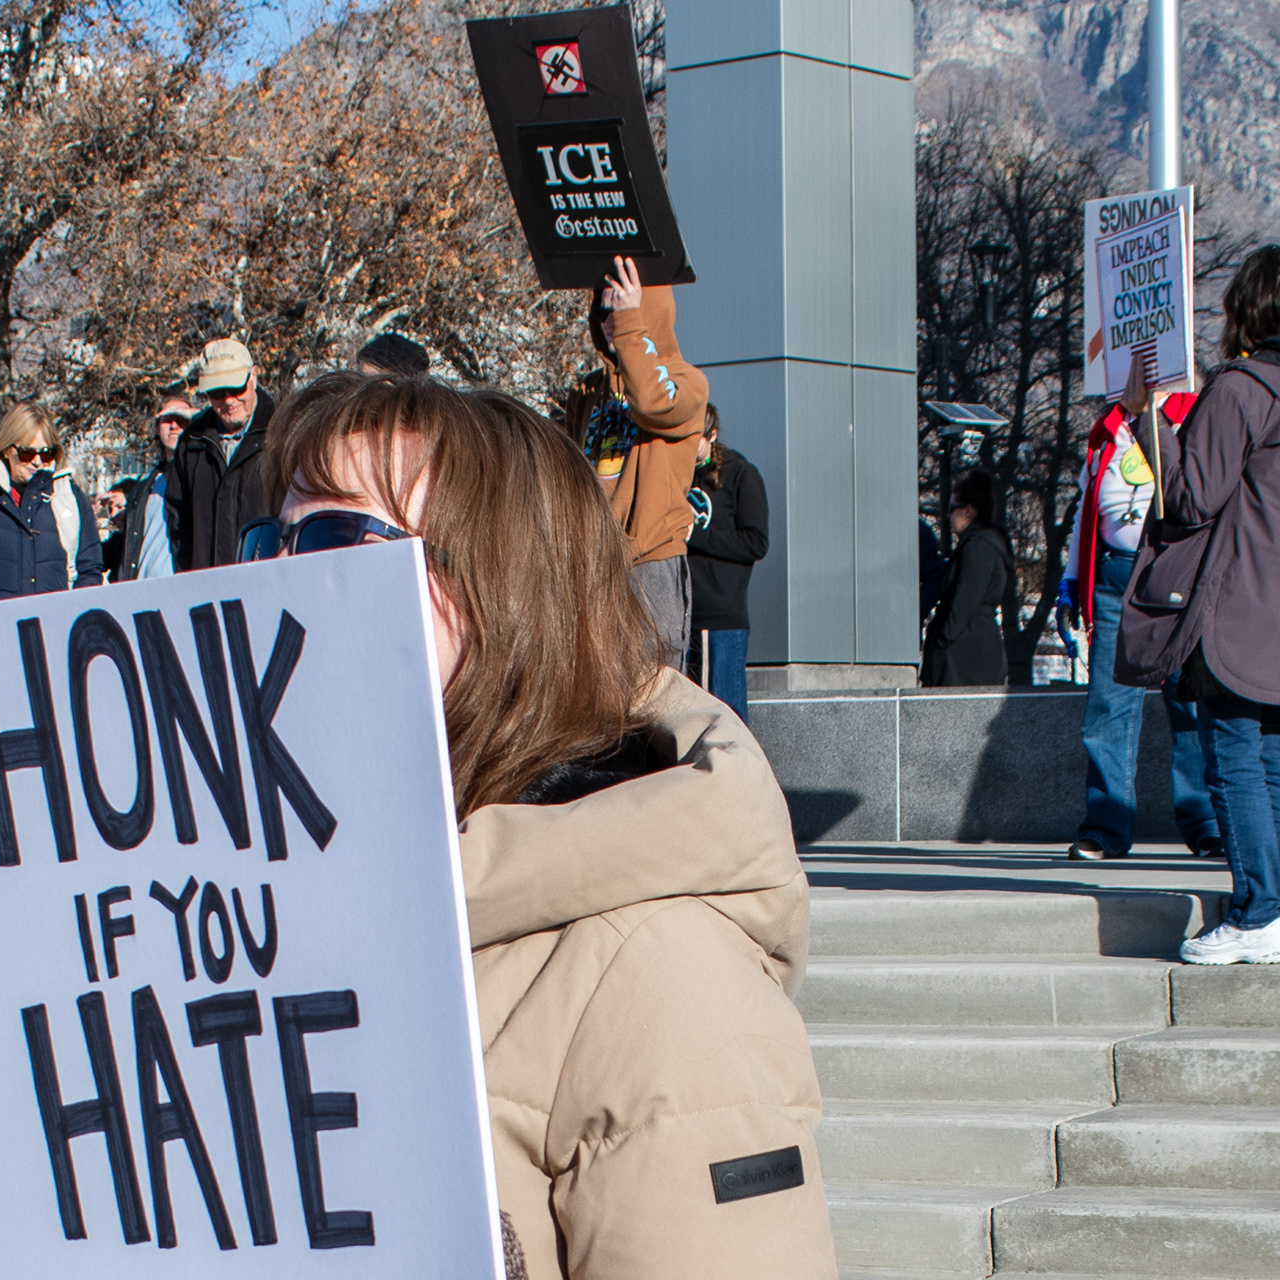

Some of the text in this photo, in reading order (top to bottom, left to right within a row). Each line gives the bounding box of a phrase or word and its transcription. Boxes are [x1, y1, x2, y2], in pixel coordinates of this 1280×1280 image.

[537, 142, 618, 186] ICE
[550, 191, 625, 210] IS THE NEW
[555, 213, 639, 240] Gestapo
[1110, 224, 1170, 269] IMPEACH
[1120, 255, 1168, 292] INDICT
[1113, 281, 1173, 320] CONVICT
[1110, 304, 1176, 351] IMPRISON
[73, 875, 278, 984] IF YOU
[20, 985, 376, 1251] HATE
